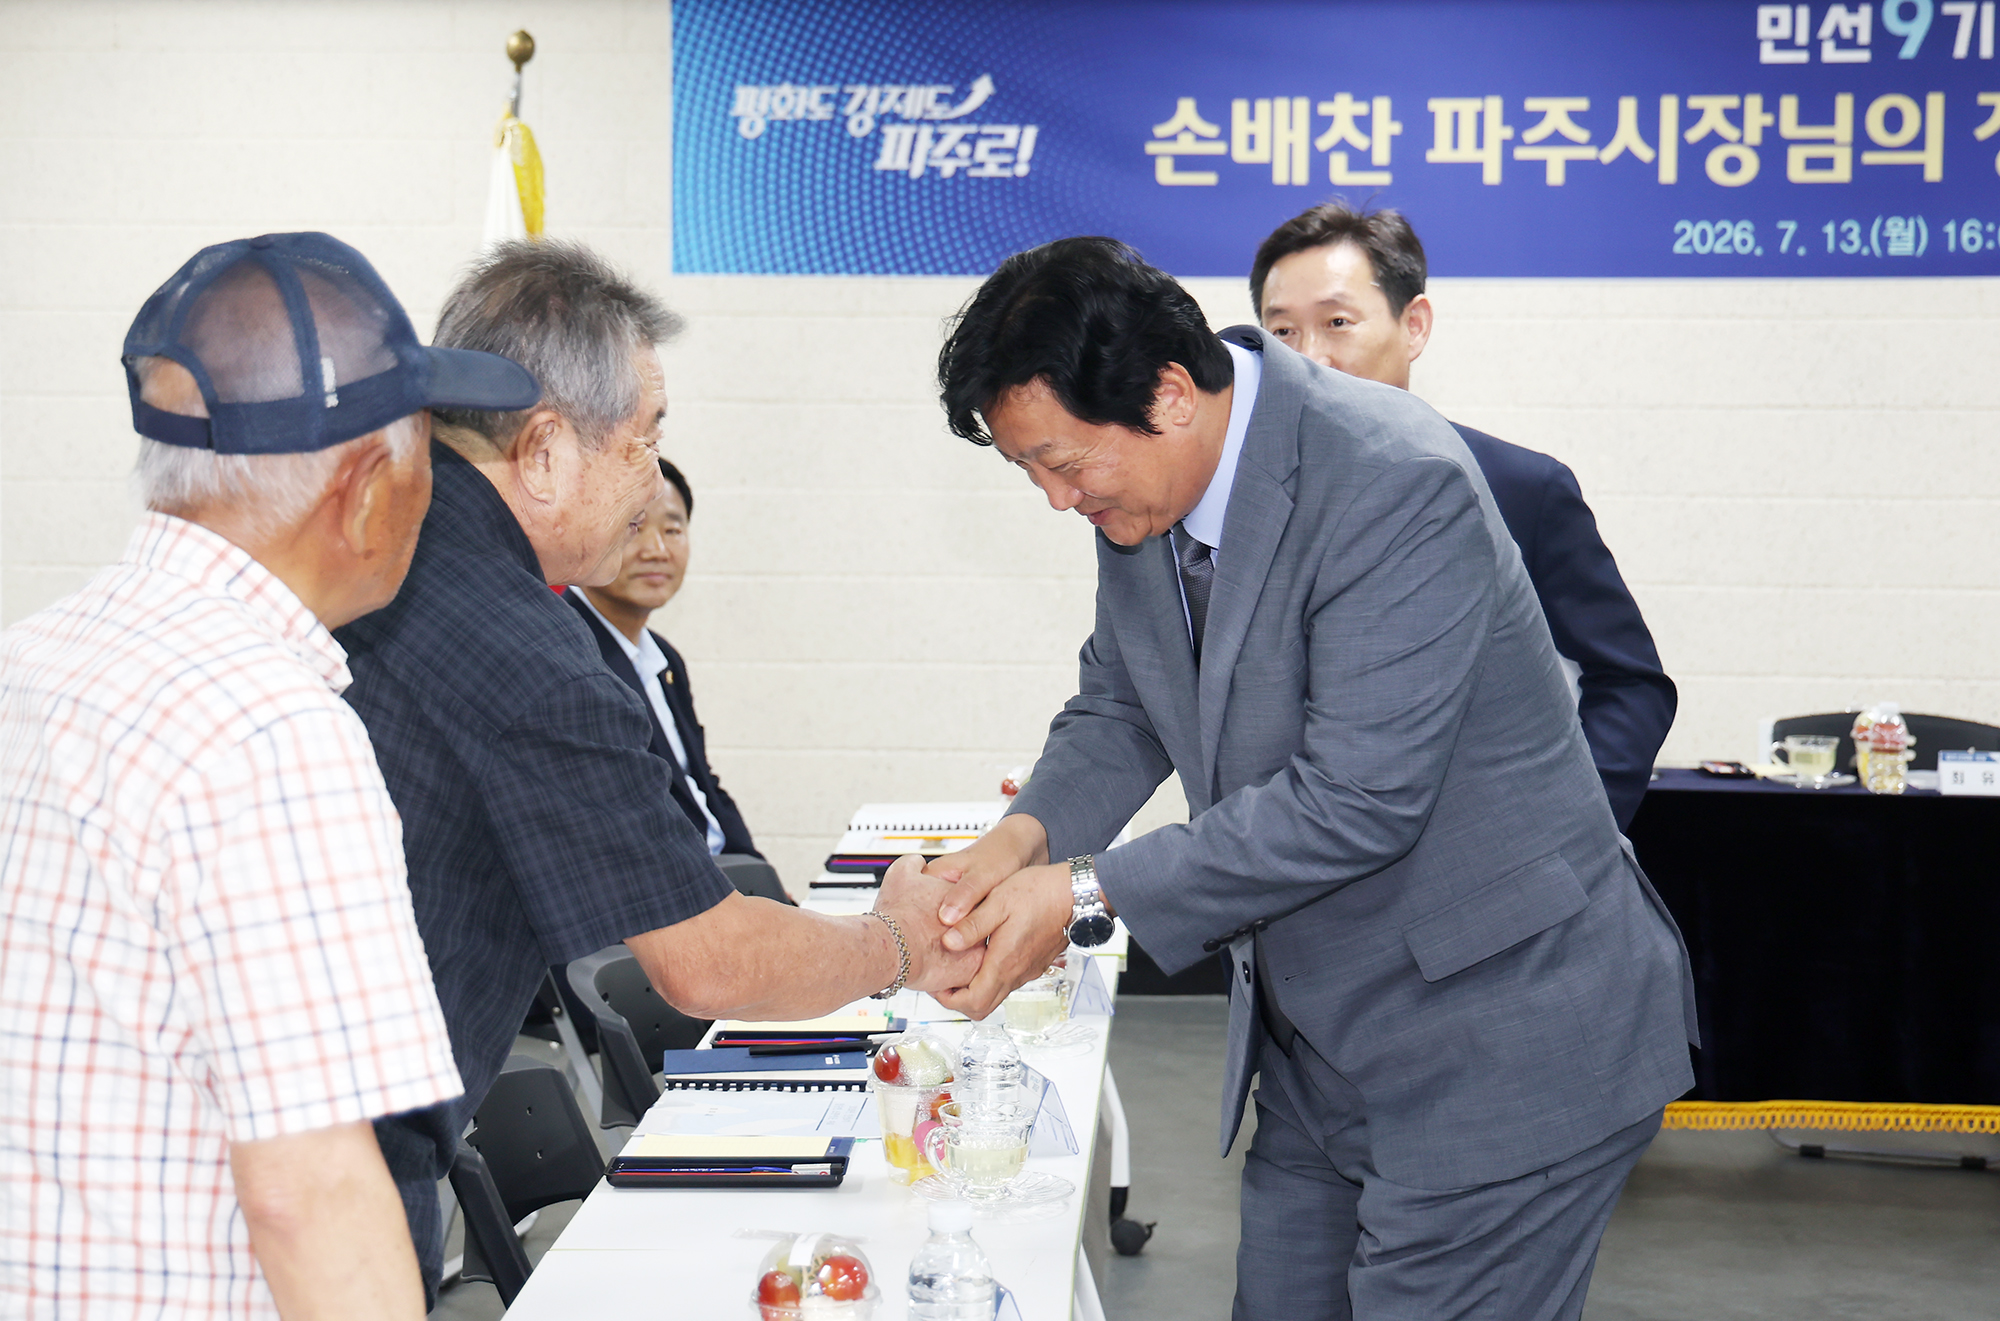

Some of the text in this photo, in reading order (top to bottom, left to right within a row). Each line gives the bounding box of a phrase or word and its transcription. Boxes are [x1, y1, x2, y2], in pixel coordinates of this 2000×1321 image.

[1757, 0, 1995, 65] 민선9기
[730, 82, 962, 140] 평화도 경제도
[1145, 92, 1403, 187] 손배찬
[1426, 92, 1945, 187] 파주시장님의
[873, 124, 1038, 179] 파주로!
[1673, 215, 2000, 258] 2026. 7. 13.(월) 16:
